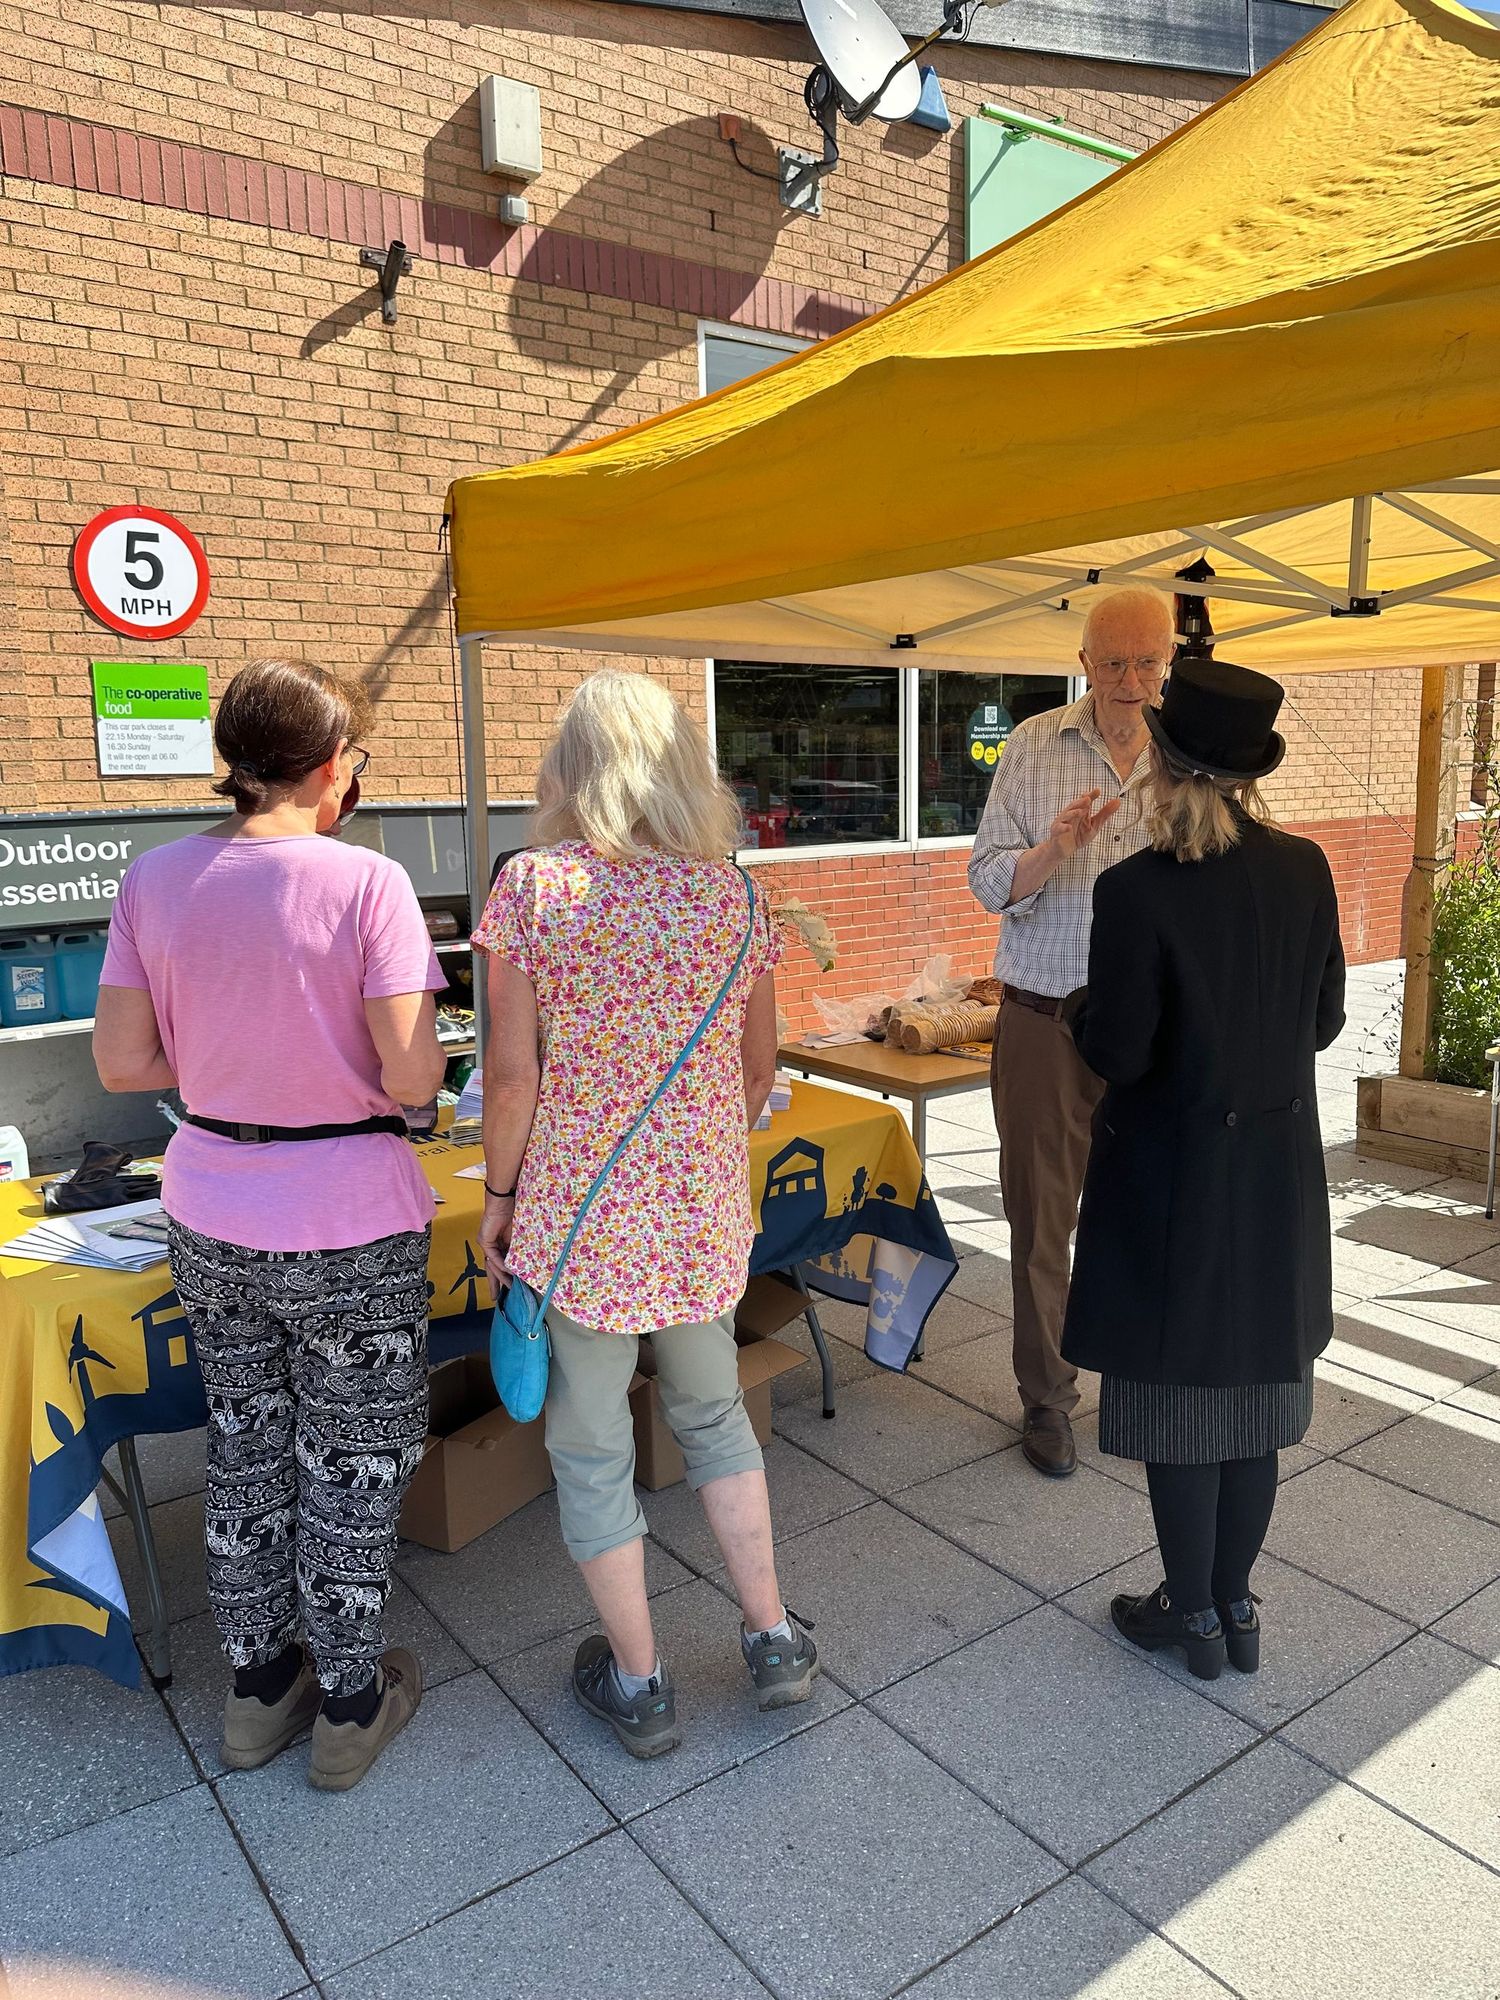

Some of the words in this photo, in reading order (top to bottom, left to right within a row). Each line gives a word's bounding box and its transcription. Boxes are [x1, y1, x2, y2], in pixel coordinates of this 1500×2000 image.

[124, 530, 164, 590] 5
[121, 597, 172, 616] MPH
[102, 685, 124, 699] The
[126, 687, 203, 702] co-operative
[105, 701, 133, 715] food
[105, 723, 119, 731] This
[132, 723, 146, 732] park
[147, 723, 167, 731] closes
[105, 733, 125, 741] 22.15
[126, 733, 151, 742] Monday
[157, 733, 185, 742] Saturday
[107, 743, 127, 751] 16.30
[127, 743, 151, 752] Sunday
[125, 754, 150, 762] re-open
[135, 764, 147, 772] day
[0, 834, 133, 867] Outdoor
[0, 869, 127, 906] ssentia
[17, 971, 40, 980] Screen
[20, 977, 40, 986] Wash
